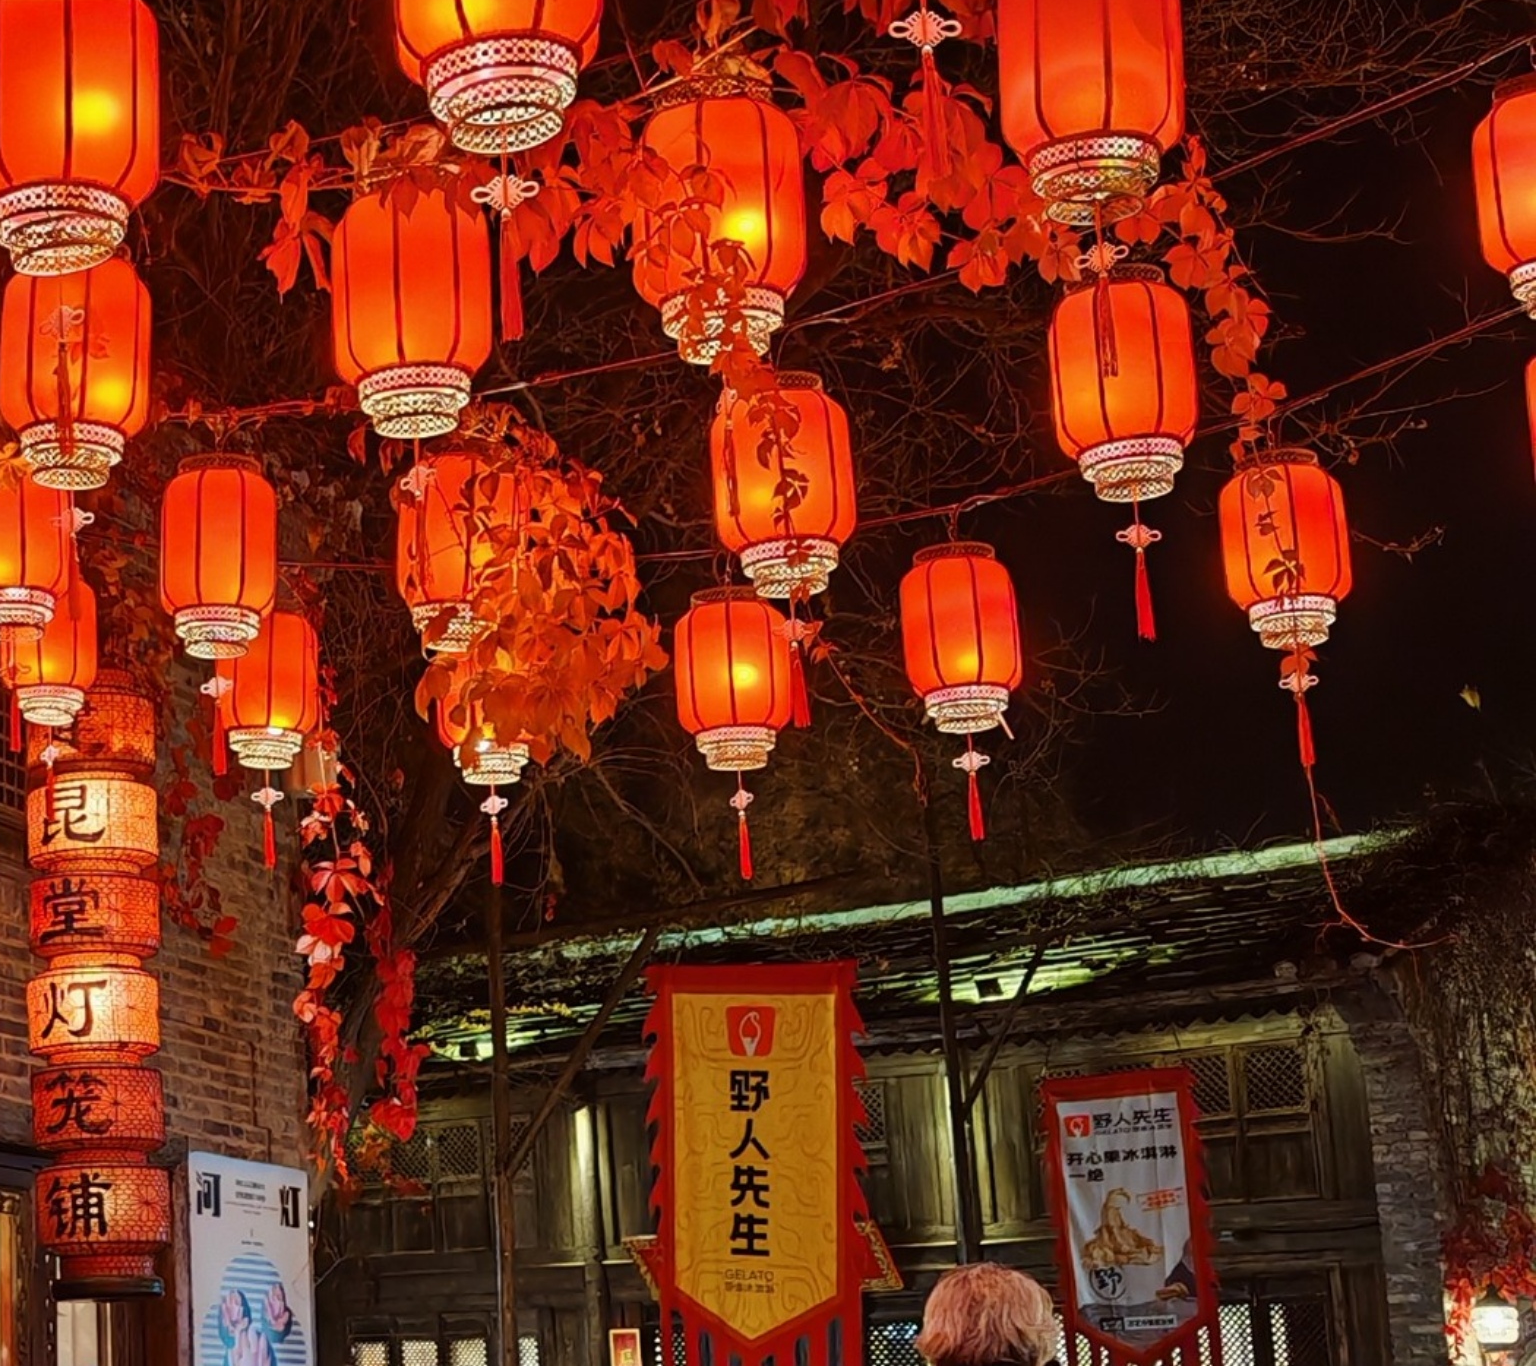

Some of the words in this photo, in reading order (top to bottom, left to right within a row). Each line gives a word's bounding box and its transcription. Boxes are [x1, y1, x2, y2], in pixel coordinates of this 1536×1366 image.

[1093, 1108, 1176, 1129] 野人先生
[729, 1069, 771, 1257] 野人先生
[1067, 1145, 1177, 1167] 开心果冰淇淋
[279, 1185, 302, 1229] 灯
[724, 1268, 775, 1283] GELATO
